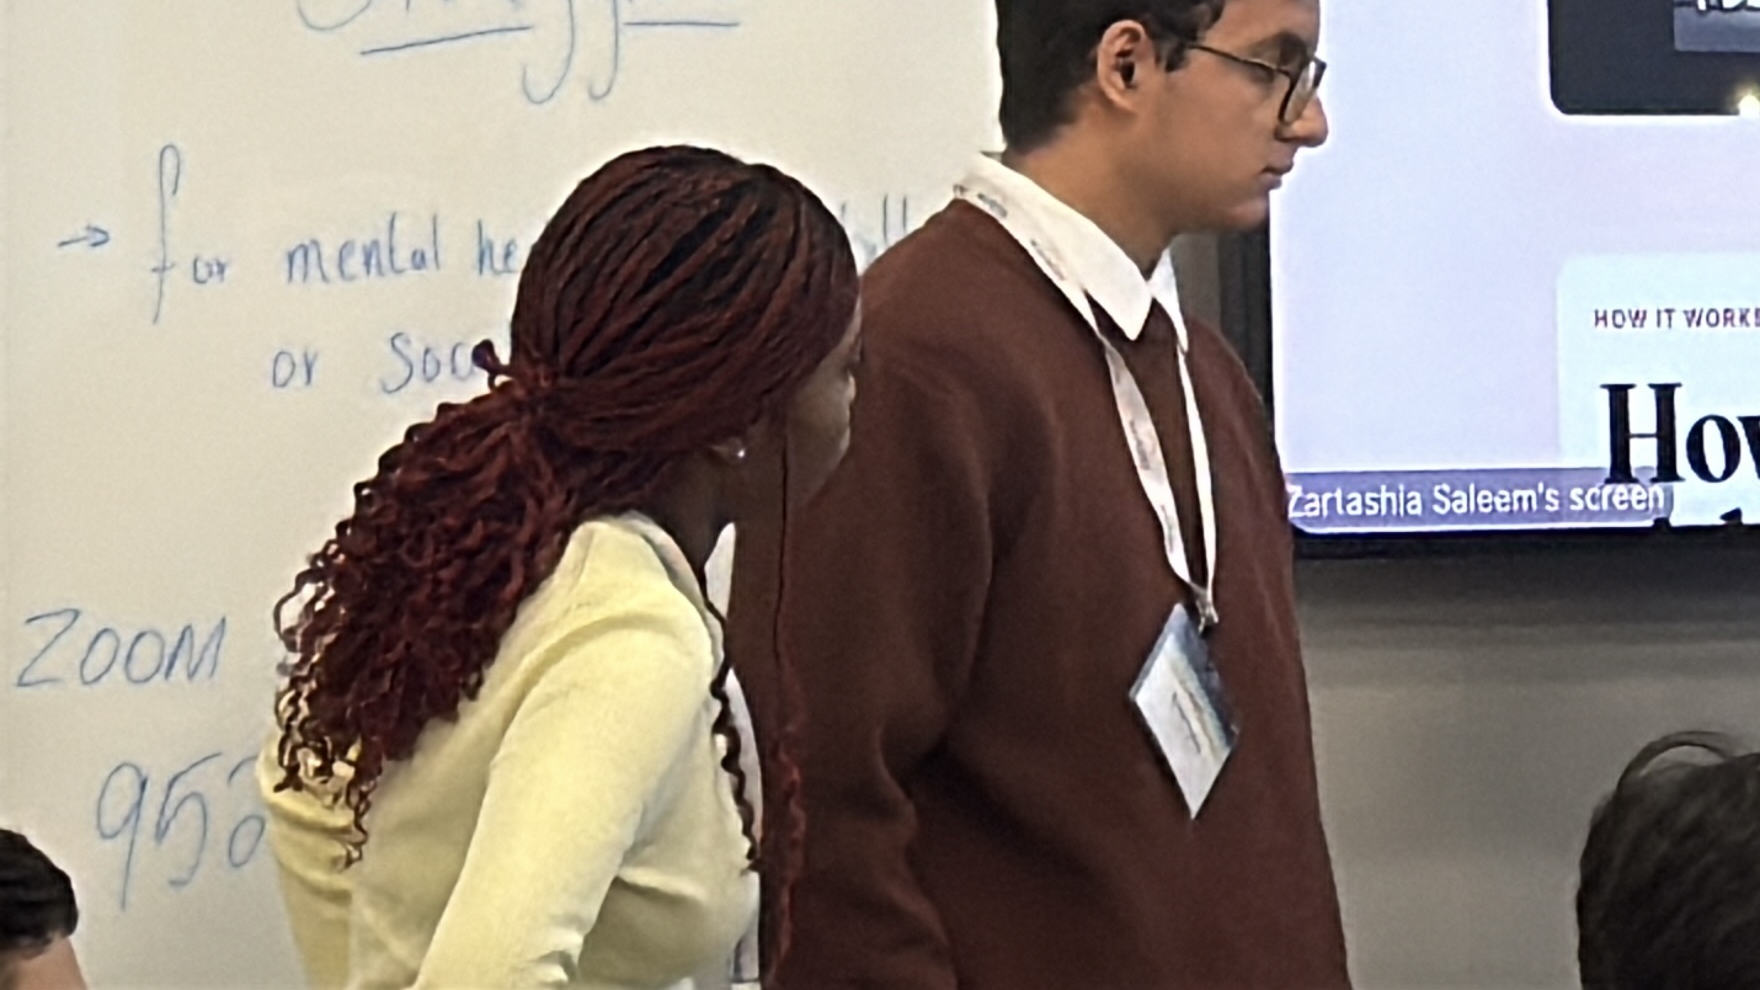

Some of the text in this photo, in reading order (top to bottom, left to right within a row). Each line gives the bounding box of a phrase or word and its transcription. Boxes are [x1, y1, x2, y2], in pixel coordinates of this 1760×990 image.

[150, 143, 521, 326] for mental he
[1594, 308, 1647, 329] HOW
[1656, 308, 1676, 329] IT
[272, 348, 320, 389] or
[1287, 481, 1665, 519] Zartashia Saleem's screen
[15, 607, 227, 688] ZOOM
